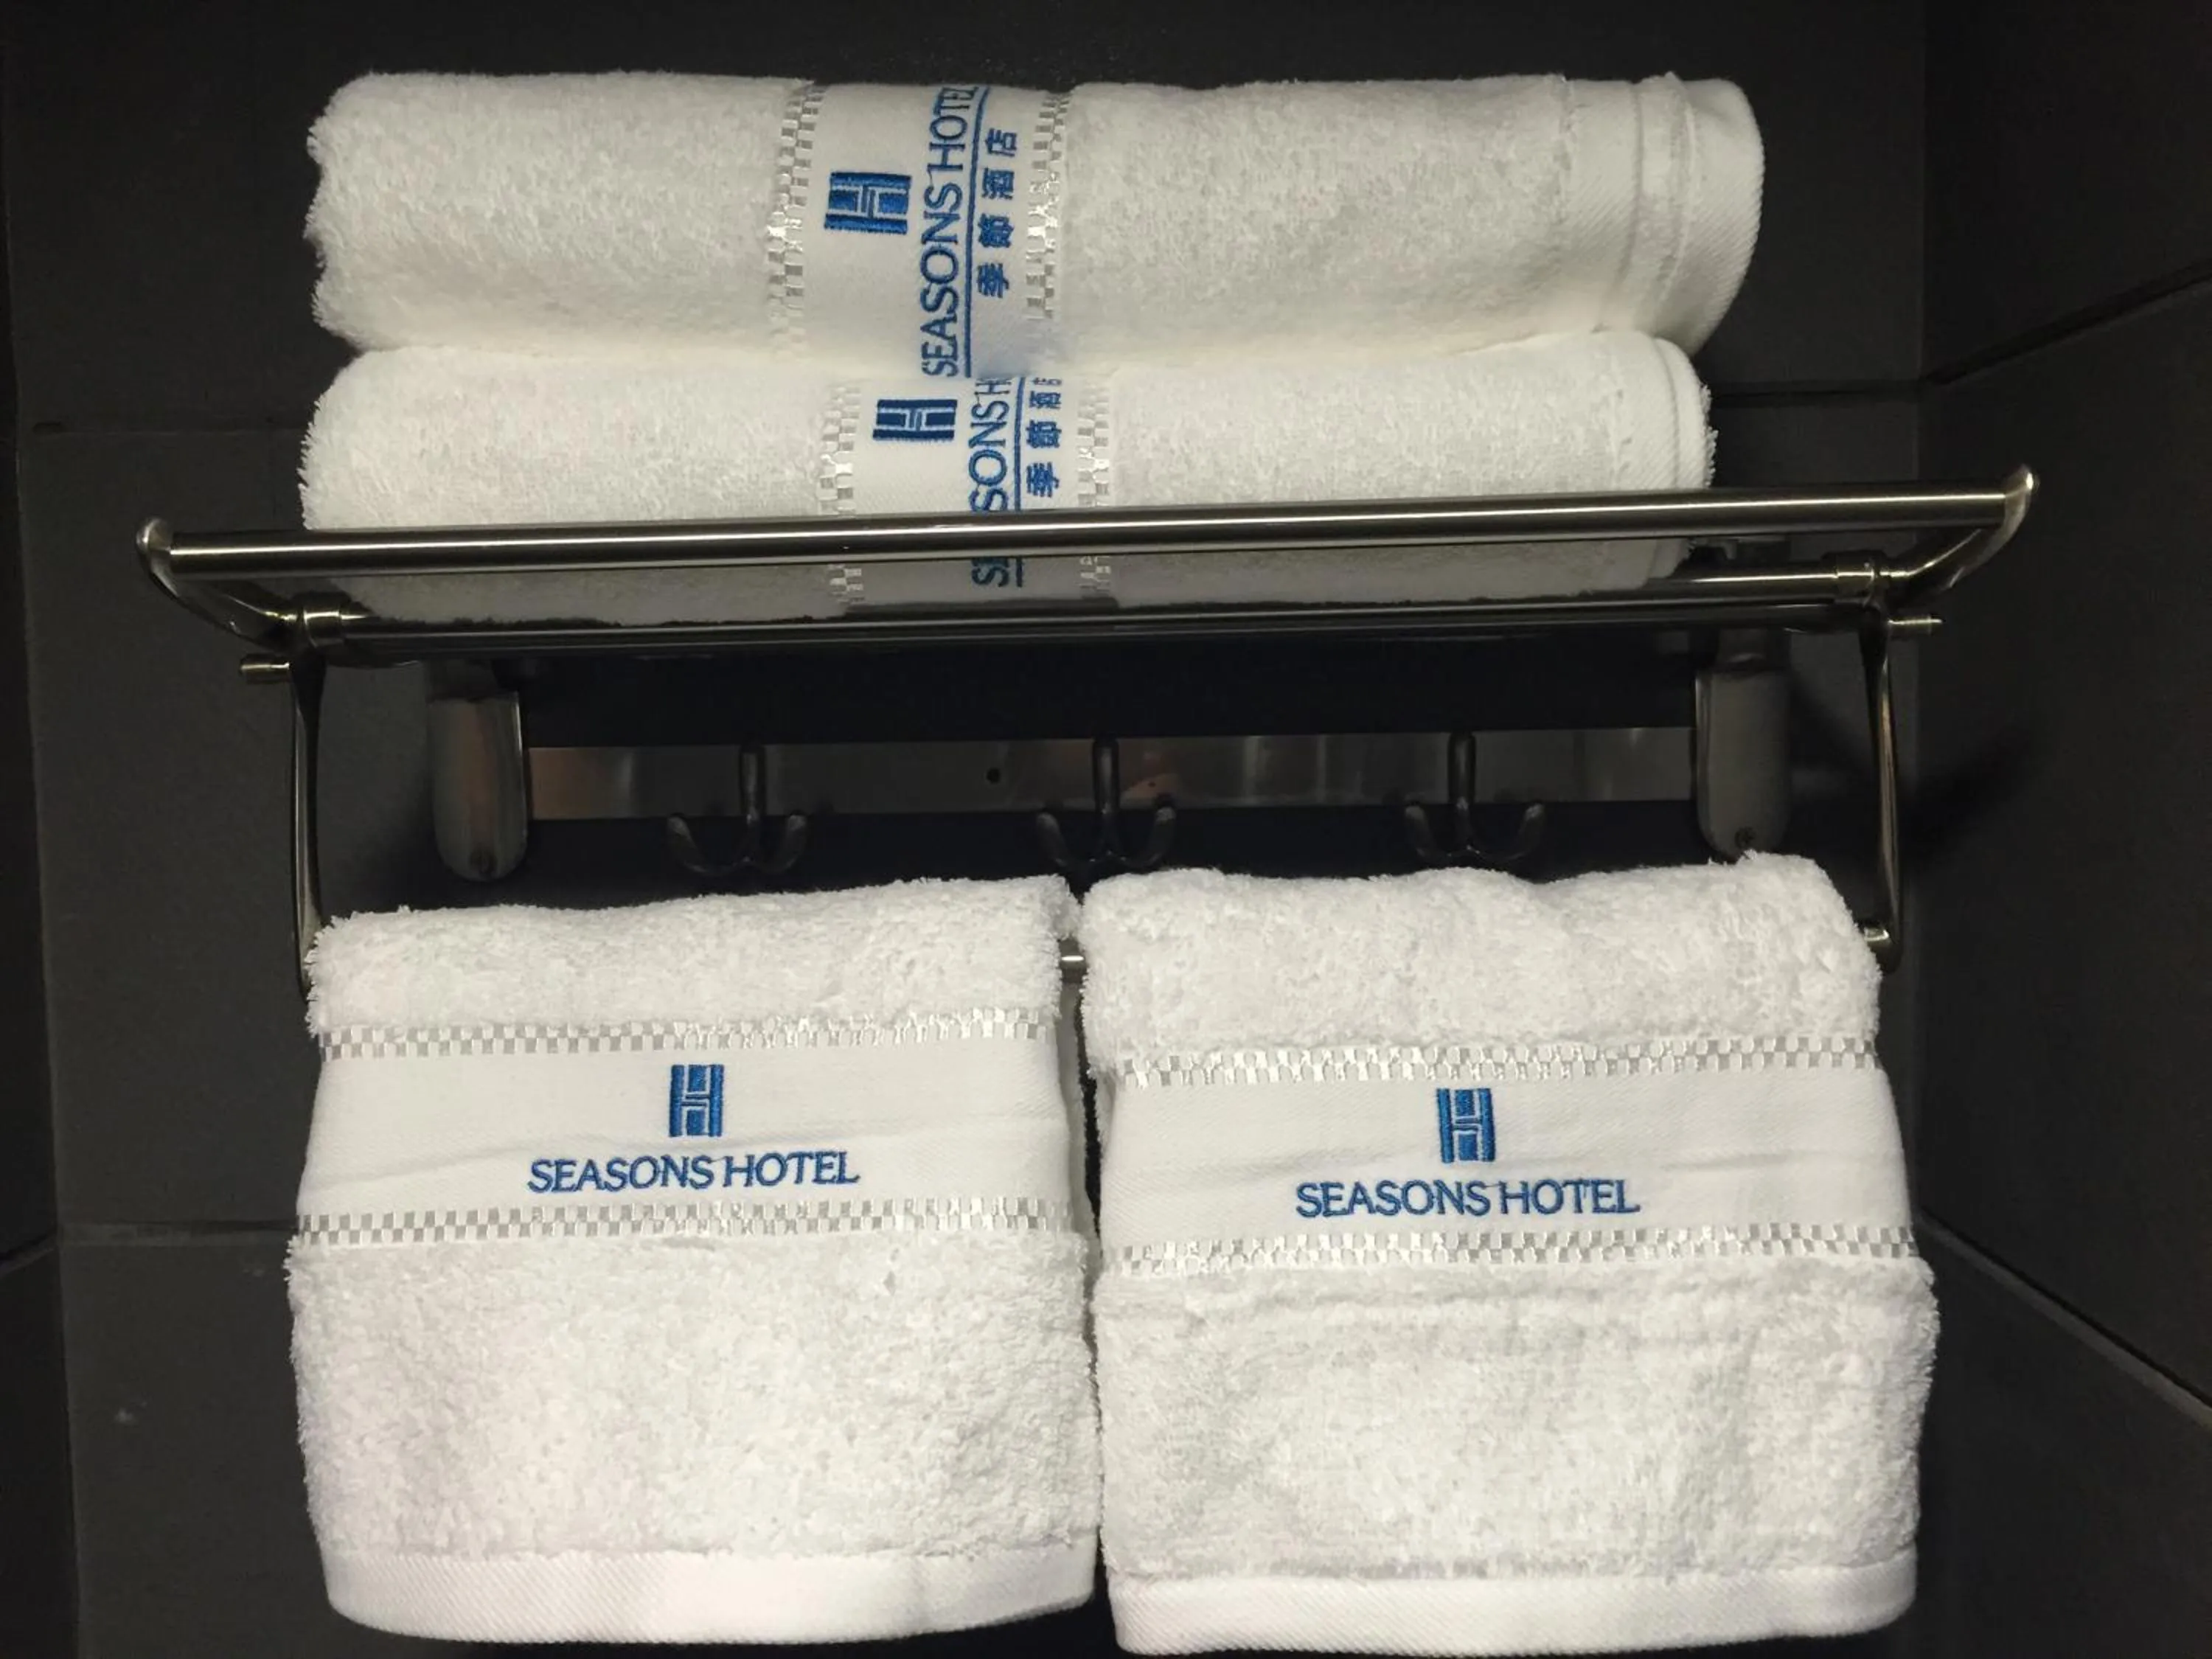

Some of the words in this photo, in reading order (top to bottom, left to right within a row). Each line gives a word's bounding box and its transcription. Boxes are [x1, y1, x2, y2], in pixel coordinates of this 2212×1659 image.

[975, 128, 1018, 299] 季節酒店
[920, 181, 964, 378] SEASONS
[527, 1153, 718, 1193] SEASONS
[725, 1149, 861, 1188] HOTEL
[1295, 1179, 1491, 1218] SEASONS
[1498, 1178, 1642, 1215] HOTEL
